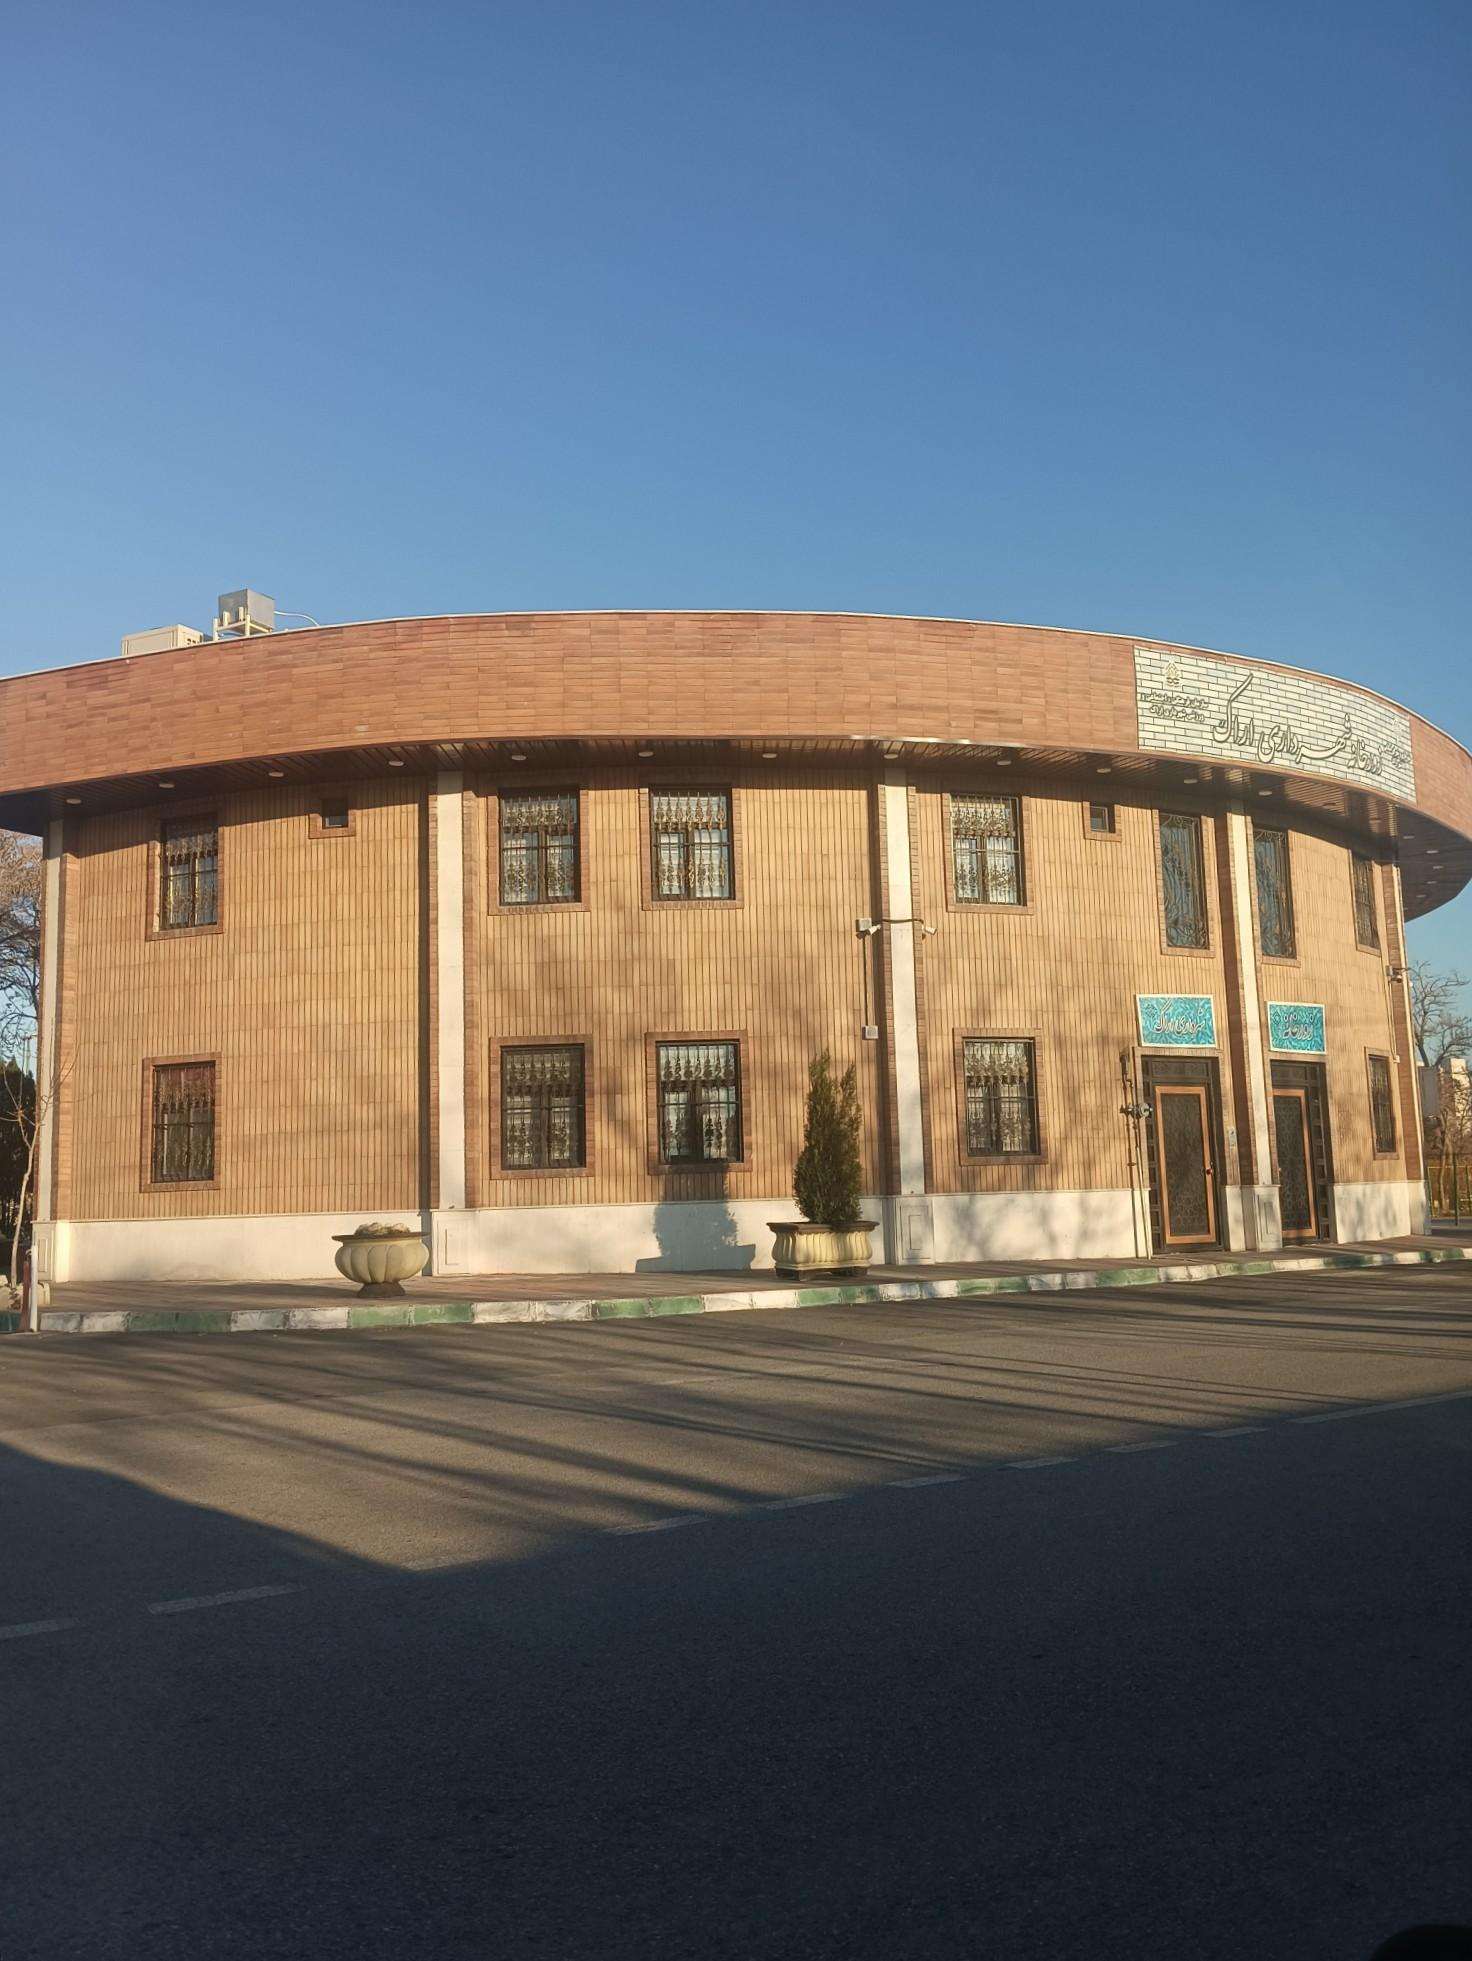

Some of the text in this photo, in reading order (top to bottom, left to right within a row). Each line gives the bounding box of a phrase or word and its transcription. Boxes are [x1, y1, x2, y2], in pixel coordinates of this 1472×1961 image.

[1212, 672, 1255, 747] اراک
[1258, 712, 1353, 764] شهرداری
[1347, 738, 1383, 776] زورخانه
[1154, 998, 1206, 1036] شهرداری اراک
[1282, 1012, 1314, 1041] زورخانه
